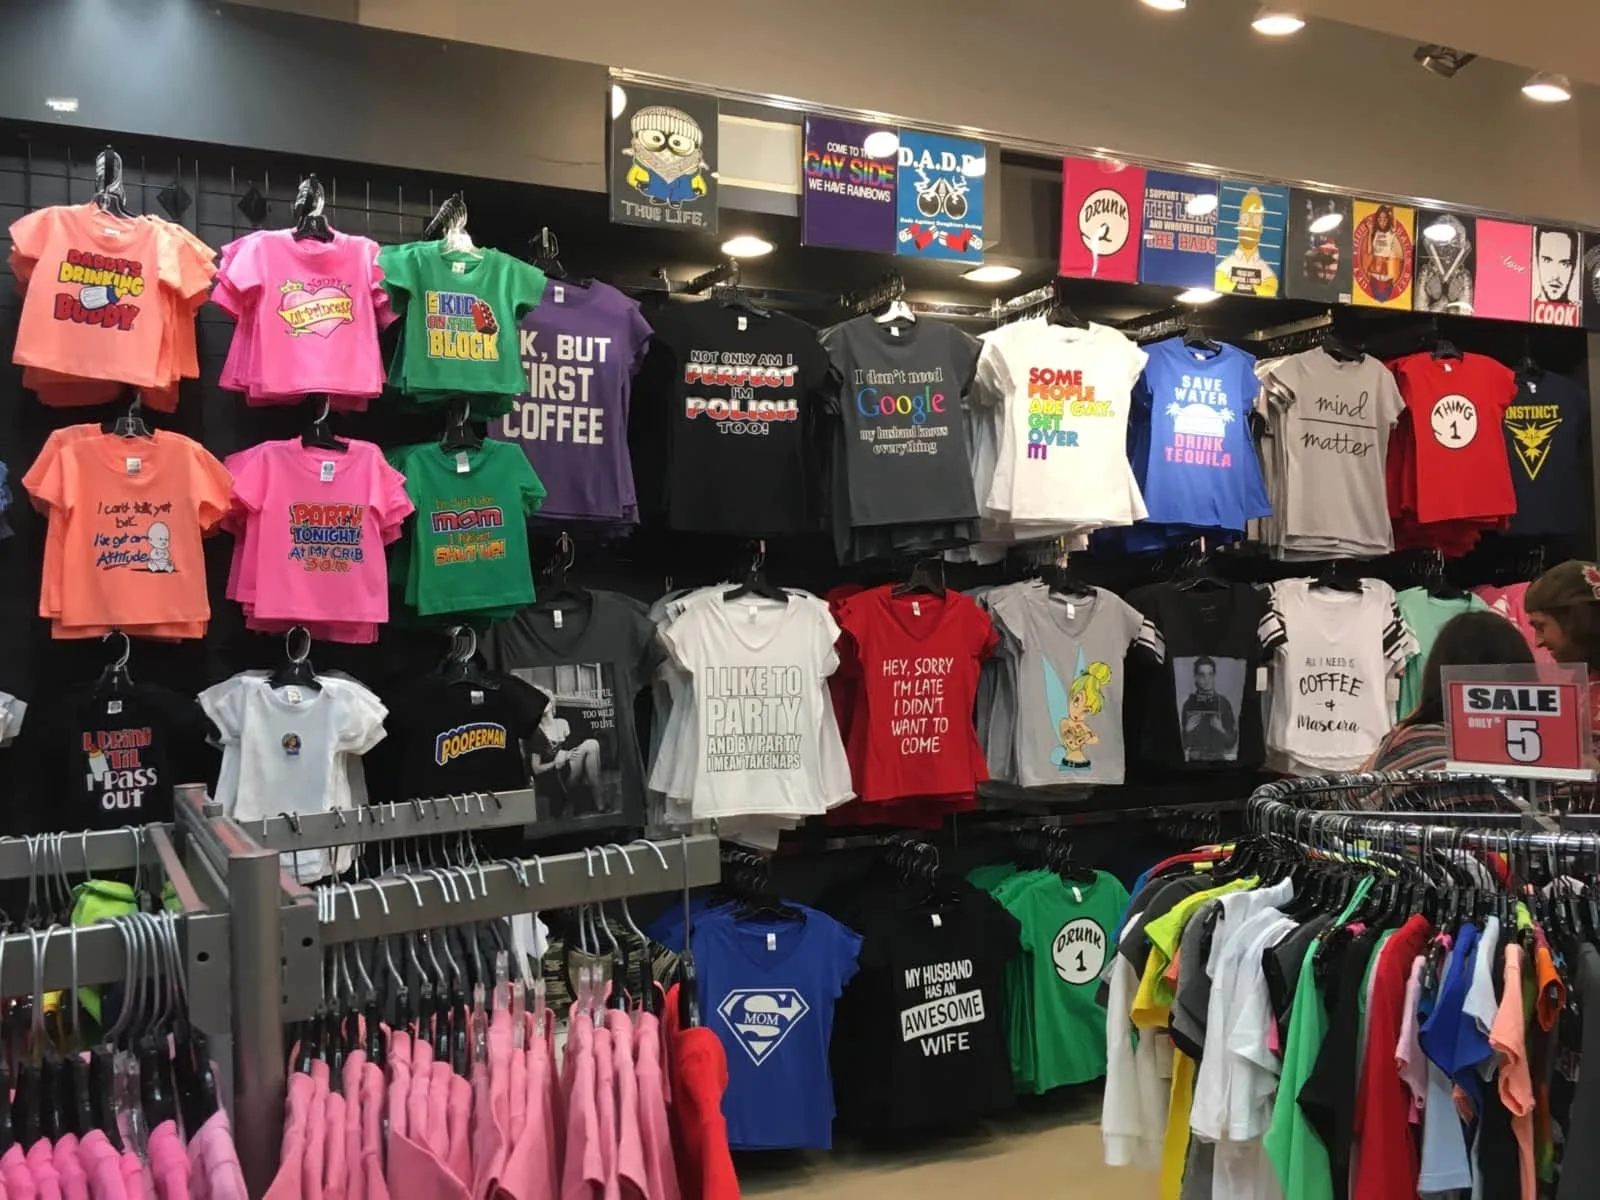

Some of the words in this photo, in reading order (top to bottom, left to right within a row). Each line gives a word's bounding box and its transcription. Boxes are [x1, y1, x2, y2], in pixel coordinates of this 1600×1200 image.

[827, 142, 848, 154] COME
[849, 146, 859, 156] TO
[804, 150, 846, 180] GAY
[850, 158, 895, 189] SIDE
[809, 178, 823, 190] WE
[824, 181, 846, 194] HAVE
[847, 185, 891, 203] RAINBOWS
[1084, 198, 1126, 223] DRUNK
[1144, 199, 1173, 219] THE
[1098, 222, 1112, 242] 2
[58, 261, 144, 296] DRINKING
[54, 293, 140, 331] BUDDY
[440, 294, 477, 316] KID
[1535, 303, 1580, 327] COOK
[428, 329, 498, 361] BLOCK
[516, 330, 548, 362] K,
[557, 334, 611, 362] BUT
[691, 350, 719, 363] NOT
[721, 352, 756, 365] ONLY
[758, 354, 783, 366] AM
[787, 354, 793, 365] I
[685, 362, 799, 388] PERFECT
[855, 369, 864, 384] I
[866, 369, 906, 384] don't
[908, 367, 944, 383] need
[1029, 367, 1083, 385] SOME
[1182, 375, 1223, 392] SAVE
[731, 387, 754, 399] I'M
[1028, 382, 1095, 402] PEOPLE
[1174, 387, 1228, 406] WATER
[685, 397, 799, 421] POLISH
[856, 385, 946, 425] Google
[1028, 398, 1064, 415] ARE
[1315, 391, 1369, 420] mind
[1433, 401, 1474, 421] THING
[1505, 404, 1559, 420] INSTINCT
[503, 401, 604, 445] COFFEE
[716, 421, 769, 435] TOO!
[1028, 413, 1063, 432] GET
[1450, 420, 1461, 439] 1
[860, 429, 876, 443] my
[876, 424, 917, 440] husband
[1028, 428, 1080, 447] OVER
[1174, 432, 1223, 452] DRINK
[873, 440, 938, 456] everything
[1300, 432, 1375, 457] matter
[1165, 447, 1232, 467] TEQUILA
[883, 659, 910, 676] HEY,
[914, 657, 954, 676] SORRY
[705, 667, 714, 696] I
[720, 666, 767, 696] LIKE
[772, 666, 802, 696] TO
[893, 680, 911, 696] I'M
[915, 678, 944, 696] LATE
[1300, 672, 1364, 697] COFFEE
[894, 700, 898, 716] I
[902, 697, 944, 715] DIDN'T
[1467, 688, 1558, 712] SALE
[706, 697, 802, 736] PARTY
[891, 718, 928, 736] WANT
[933, 717, 949, 733] TO
[1297, 714, 1360, 733] Mascara
[1468, 717, 1493, 728] ONLY
[435, 722, 507, 766] POOPERMAN
[708, 736, 735, 755] AND
[737, 736, 755, 754] BY
[757, 735, 801, 752] PARTY
[901, 736, 941, 755] COME
[1504, 718, 1543, 764] 5
[707, 757, 712, 772] I
[713, 755, 742, 771] MEAN
[744, 754, 770, 770] TAKE
[772, 753, 801, 769] NAPS
[87, 774, 94, 791] I
[1057, 927, 1102, 953] DRUNK
[1075, 949, 1087, 972] 1
[905, 967, 921, 989] MY
[923, 959, 973, 985] HUSBAND
[925, 983, 942, 1000] HAS
[944, 981, 957, 996] AN
[744, 1012, 780, 1026] MOM
[905, 994, 982, 1036] AWESOME
[920, 1032, 971, 1057] WIFE
